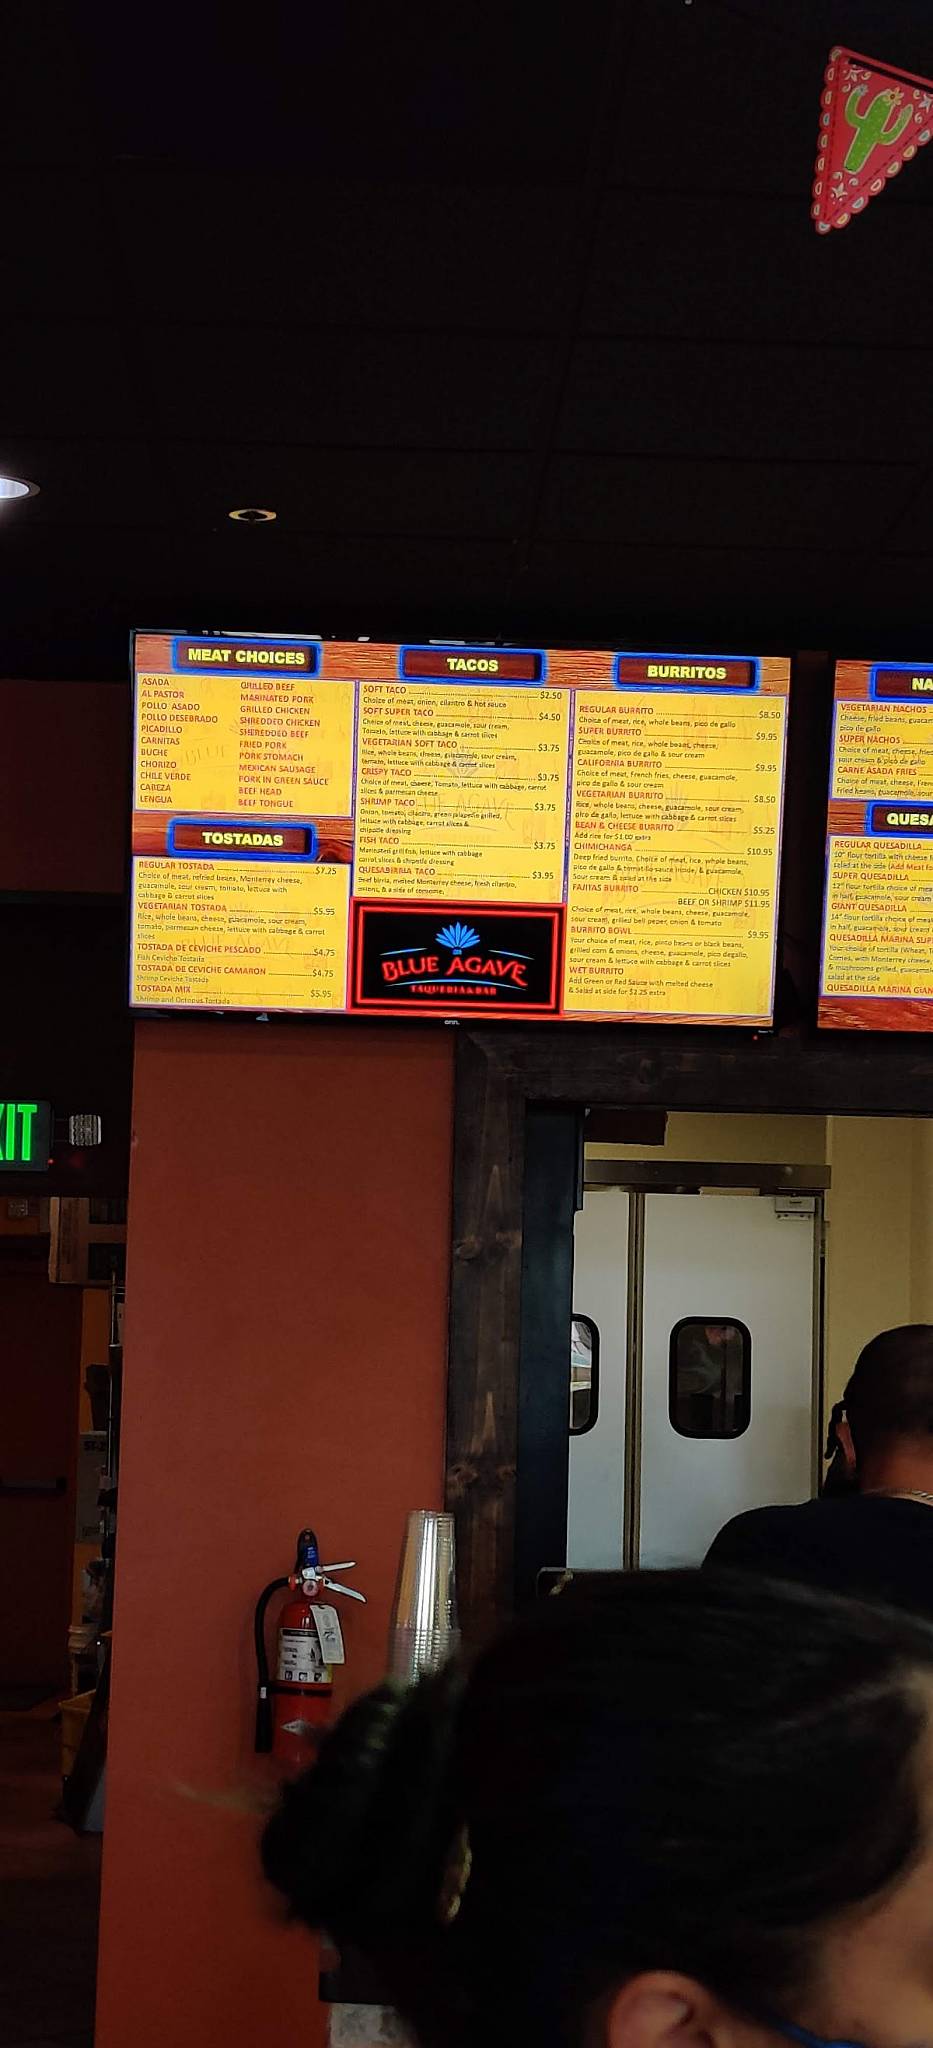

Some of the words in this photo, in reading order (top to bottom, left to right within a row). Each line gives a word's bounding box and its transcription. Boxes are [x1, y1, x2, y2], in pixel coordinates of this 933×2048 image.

[188, 648, 231, 661] MEAT
[235, 650, 305, 664] CHOICES
[447, 658, 499, 671] TACOS
[647, 665, 727, 679] BURRITOS
[142, 678, 169, 686] ASADA
[240, 682, 274, 690] GRILLED
[385, 686, 406, 694] TACO
[240, 694, 288, 703] MARINATED
[292, 696, 314, 704] PORK
[240, 706, 273, 714] GRILLED
[275, 707, 310, 715] CHICKEN
[579, 706, 616, 714] REGULAR
[619, 707, 654, 715] BURRITO
[759, 711, 780, 719] $8.50
[841, 704, 890, 712] VEGETARIAN
[893, 705, 927, 713] NACHOS
[363, 707, 383, 715] SOFT
[385, 708, 410, 716] SUPER
[539, 713, 560, 721] $4.50
[170, 715, 218, 723] DESEBRADO
[240, 717, 283, 726] SHREDDED
[579, 727, 604, 735] SUPER
[607, 728, 641, 736] BURRITO
[141, 737, 180, 745] CARNITAS
[840, 735, 864, 743] SUPER
[867, 736, 900, 744] NACHOS
[362, 739, 412, 747] VEGETARIAN
[415, 740, 434, 748] SOFT
[538, 744, 559, 752] $3.75
[264, 753, 303, 761] STOMACH
[239, 764, 276, 772] MEXICAN
[578, 759, 624, 767] CALIFORNIA
[756, 764, 776, 772] $9.95
[140, 772, 162, 780] CHILE
[165, 773, 191, 781] VERDE
[361, 768, 388, 776] CRISPY
[538, 774, 559, 782] $3.75
[274, 777, 300, 785] GREEN
[140, 784, 171, 792] CABEZA
[260, 788, 282, 796] HEAD
[577, 790, 625, 798] VEGETARIAN
[140, 796, 172, 804] LENGUA
[361, 798, 391, 806] SHRIMP
[395, 799, 415, 807] TACO
[535, 803, 556, 811] $3.75
[887, 813, 933, 826] QUES
[576, 821, 598, 829] BEAN
[202, 832, 283, 846] TOSTADAS
[534, 842, 555, 850] $3.75
[574, 843, 632, 851] CHIMICHANGA
[315, 867, 336, 875] $7.25
[573, 884, 601, 892] FAJITAS
[604, 884, 639, 892] BURRITO
[708, 888, 742, 896] CHICKEN
[138, 902, 187, 911] VEGETARIAN
[191, 904, 227, 912] TOSTADA
[678, 898, 696, 906] BEEF
[712, 899, 742, 907] SHRIMP
[744, 900, 770, 908] $11.95
[859, 904, 907, 912] QUESADILLA
[571, 926, 606, 934] BURRITO
[608, 927, 632, 935] BOWL
[748, 931, 769, 939] $9.95
[830, 934, 878, 942] QUESADILLA
[138, 943, 173, 951] TOSTADA
[314, 949, 335, 957] $4.75
[138, 964, 173, 972] TOSTADA
[176, 965, 186, 973] DE
[224, 967, 266, 975] CAMARON
[312, 969, 334, 977] $4.75
[382, 957, 439, 981] BLUE
[445, 957, 528, 986] AGAVE
[589, 967, 624, 975] BURRITO
[175, 985, 191, 993] MIX
[311, 990, 331, 998] $5.95
[827, 984, 875, 992] QUESADILLA
[0, 1104, 37, 1160] IT
